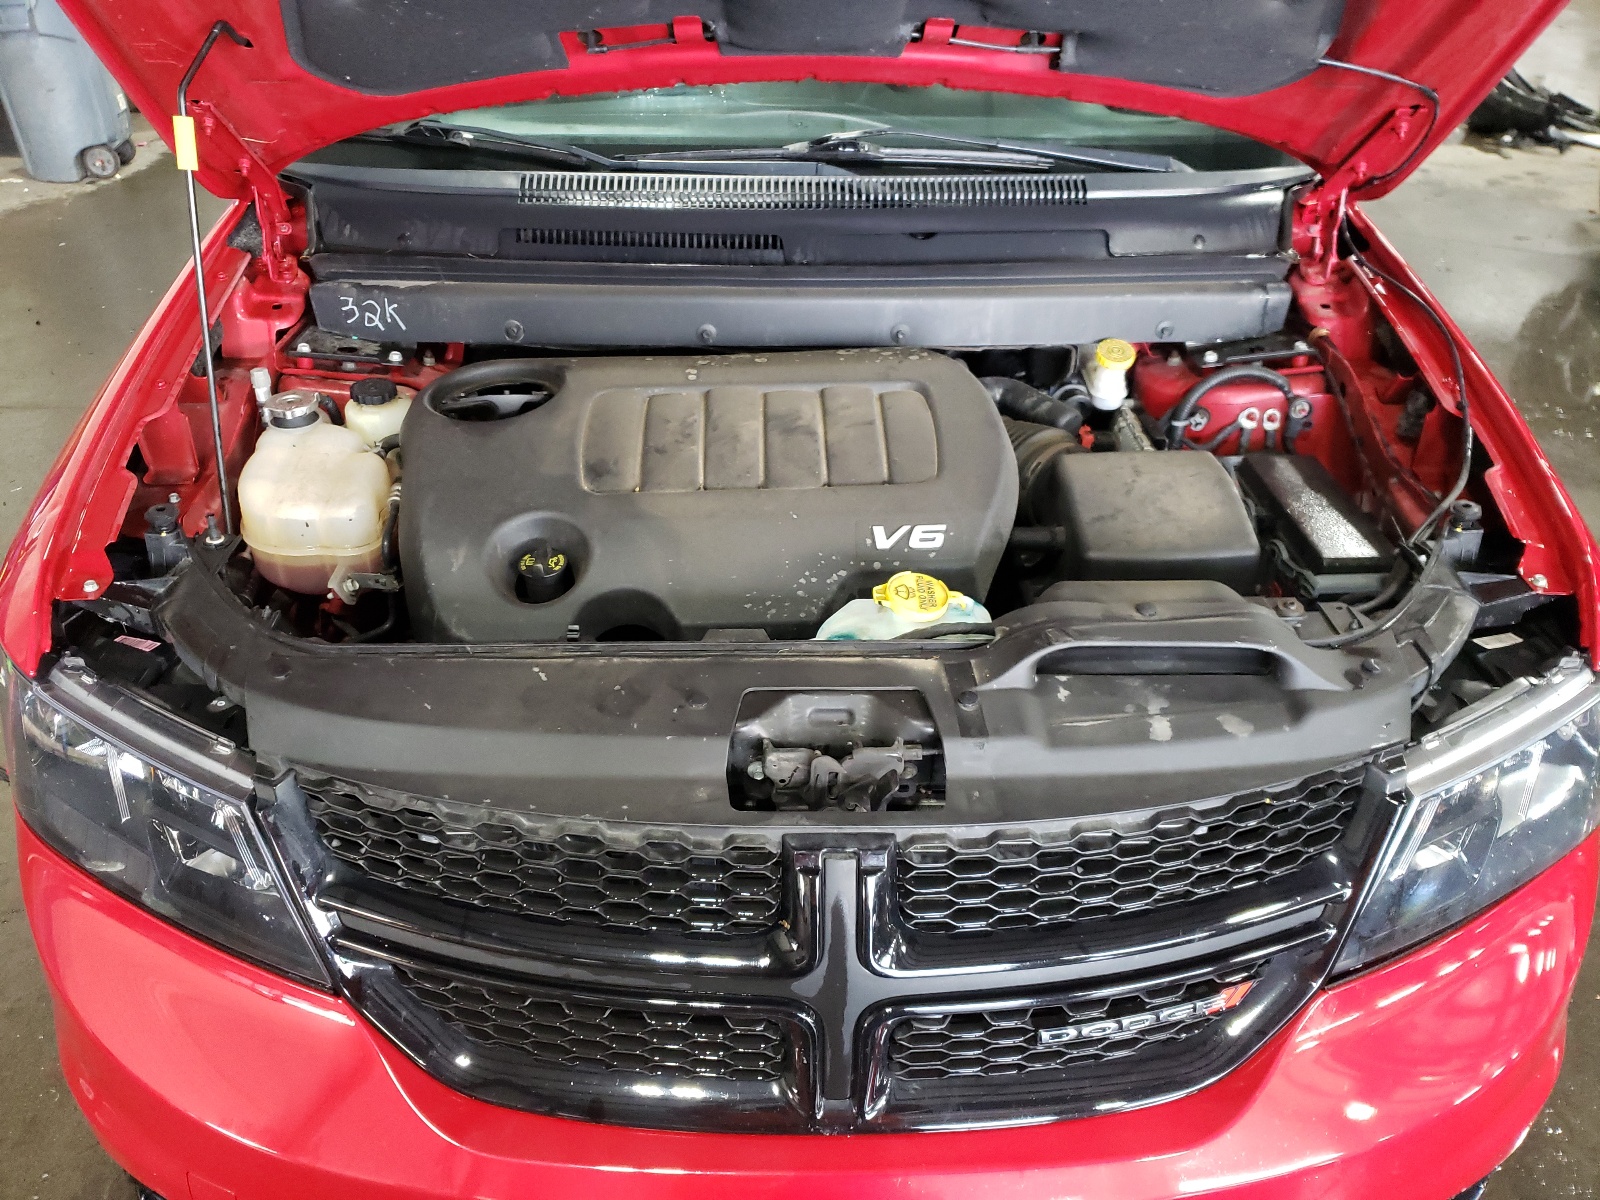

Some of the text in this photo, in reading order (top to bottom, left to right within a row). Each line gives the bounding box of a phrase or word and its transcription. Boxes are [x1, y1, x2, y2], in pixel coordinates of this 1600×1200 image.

[339, 296, 407, 331] 32K
[872, 524, 947, 549] V6
[915, 575, 929, 611] FLUID ONLY
[926, 580, 938, 608] WASHER
[1038, 993, 1227, 1044] DODGE
